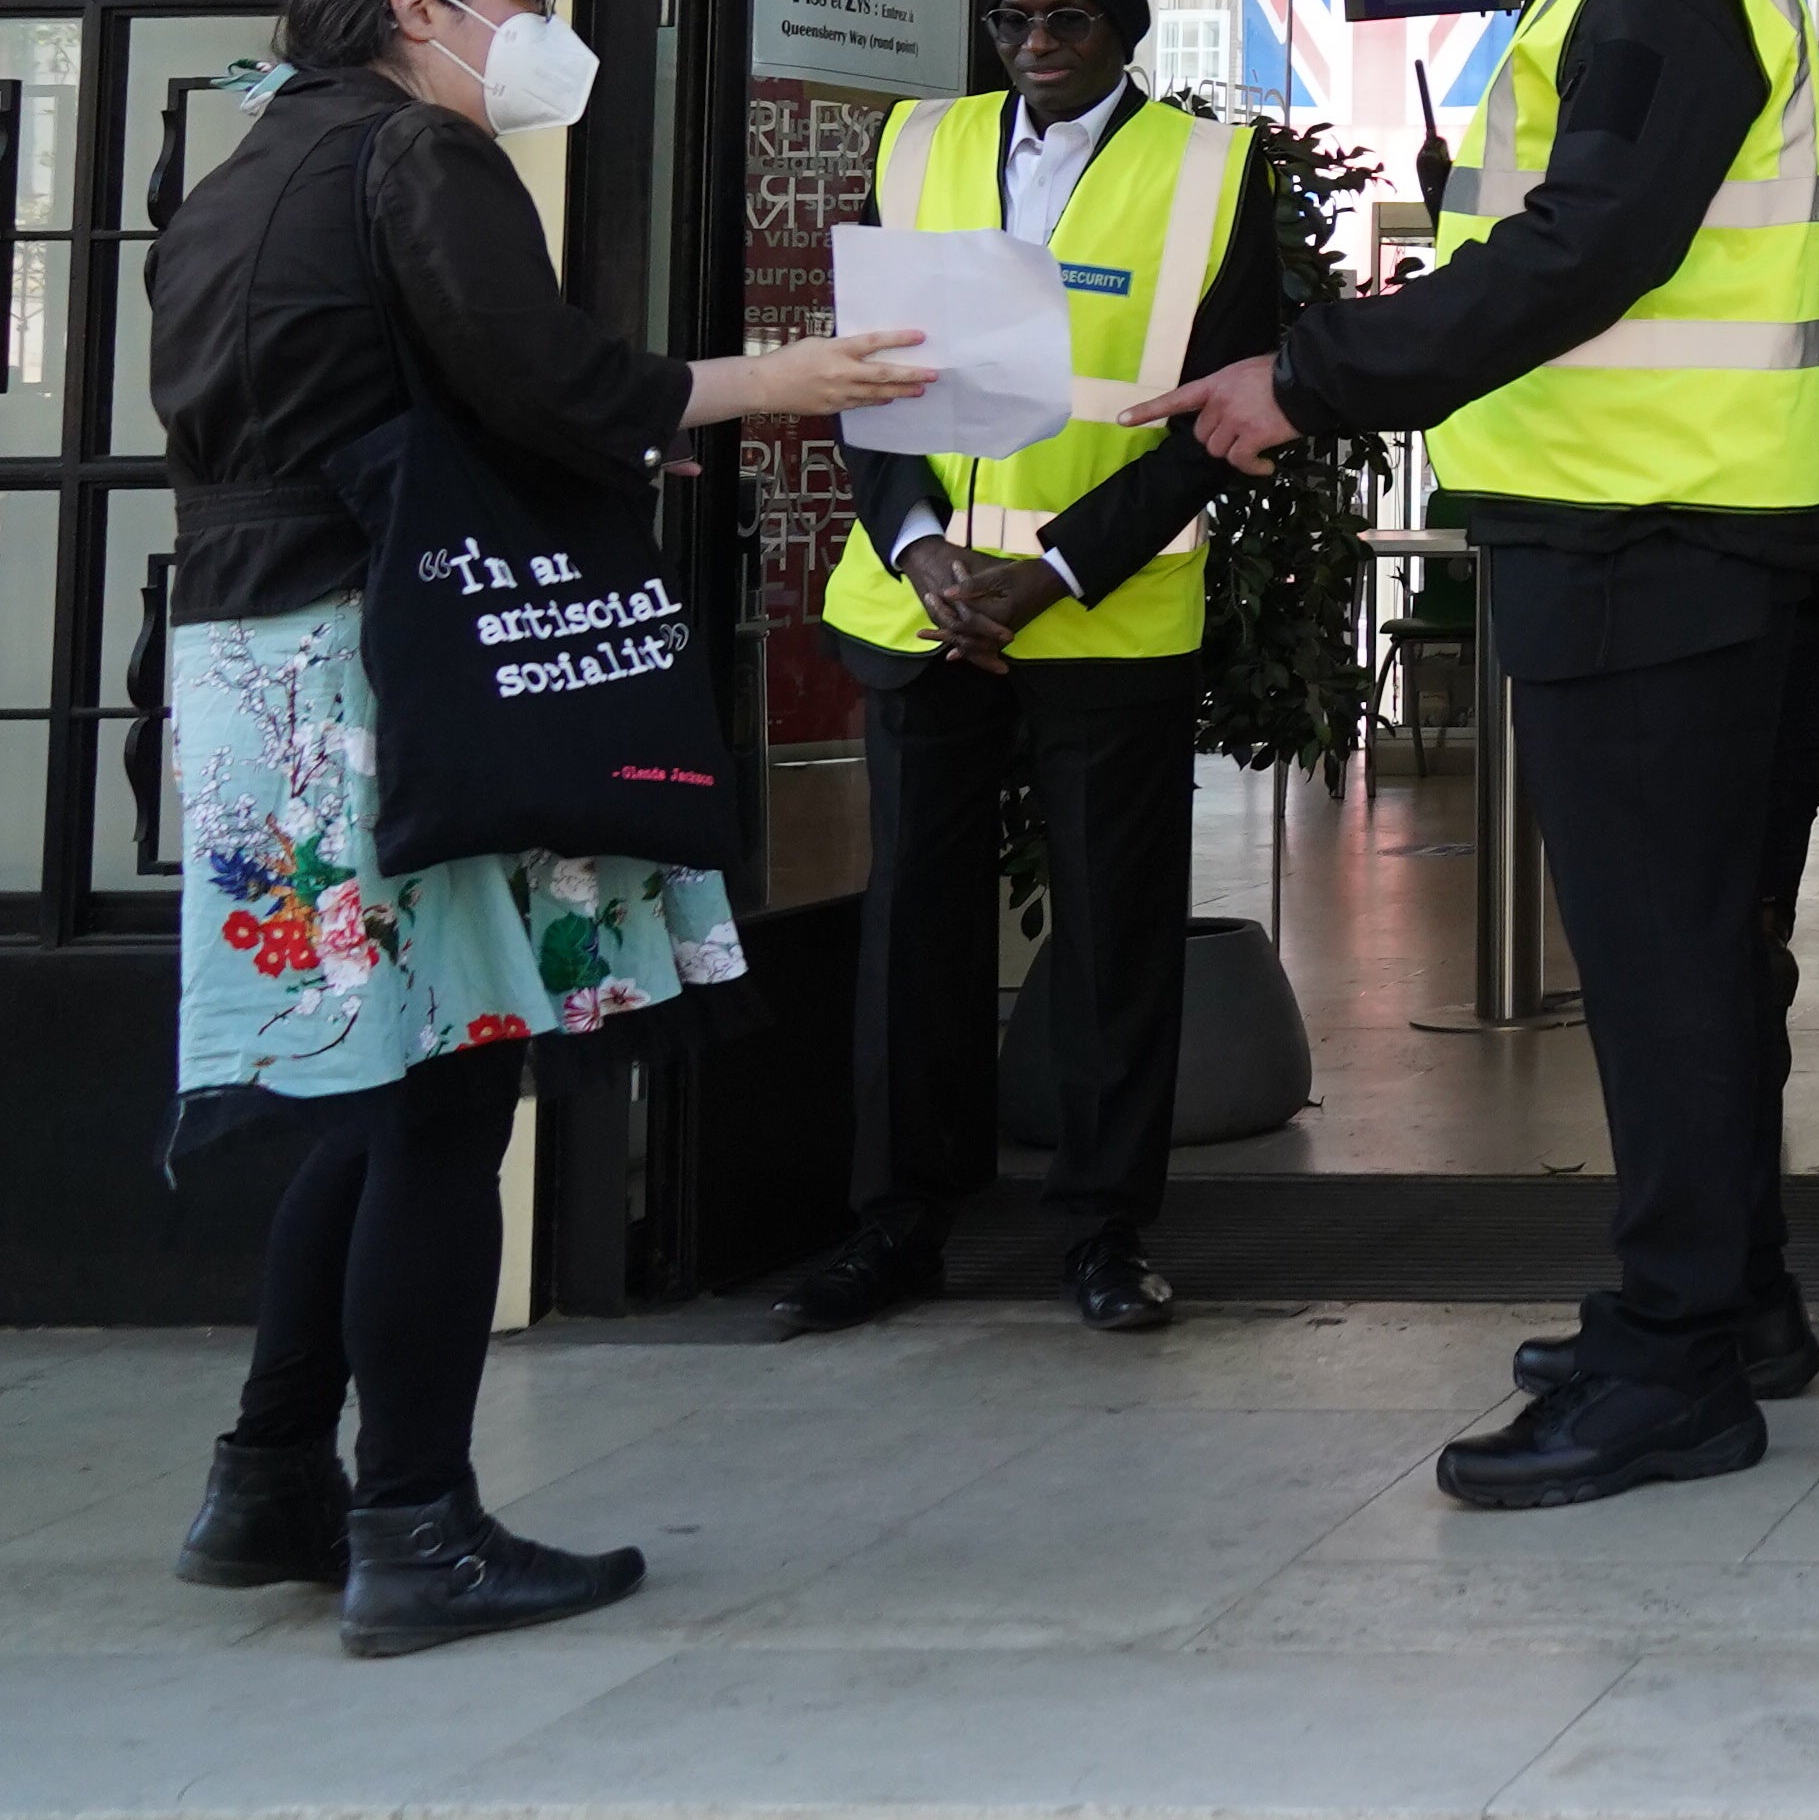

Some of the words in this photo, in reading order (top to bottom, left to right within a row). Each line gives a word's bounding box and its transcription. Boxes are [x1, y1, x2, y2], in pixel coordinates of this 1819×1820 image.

[881, 4, 908, 22] Entrez
[781, 19, 848, 44] Queensberry
[848, 30, 868, 49] Way
[1061, 269, 1125, 289] SECURITY
